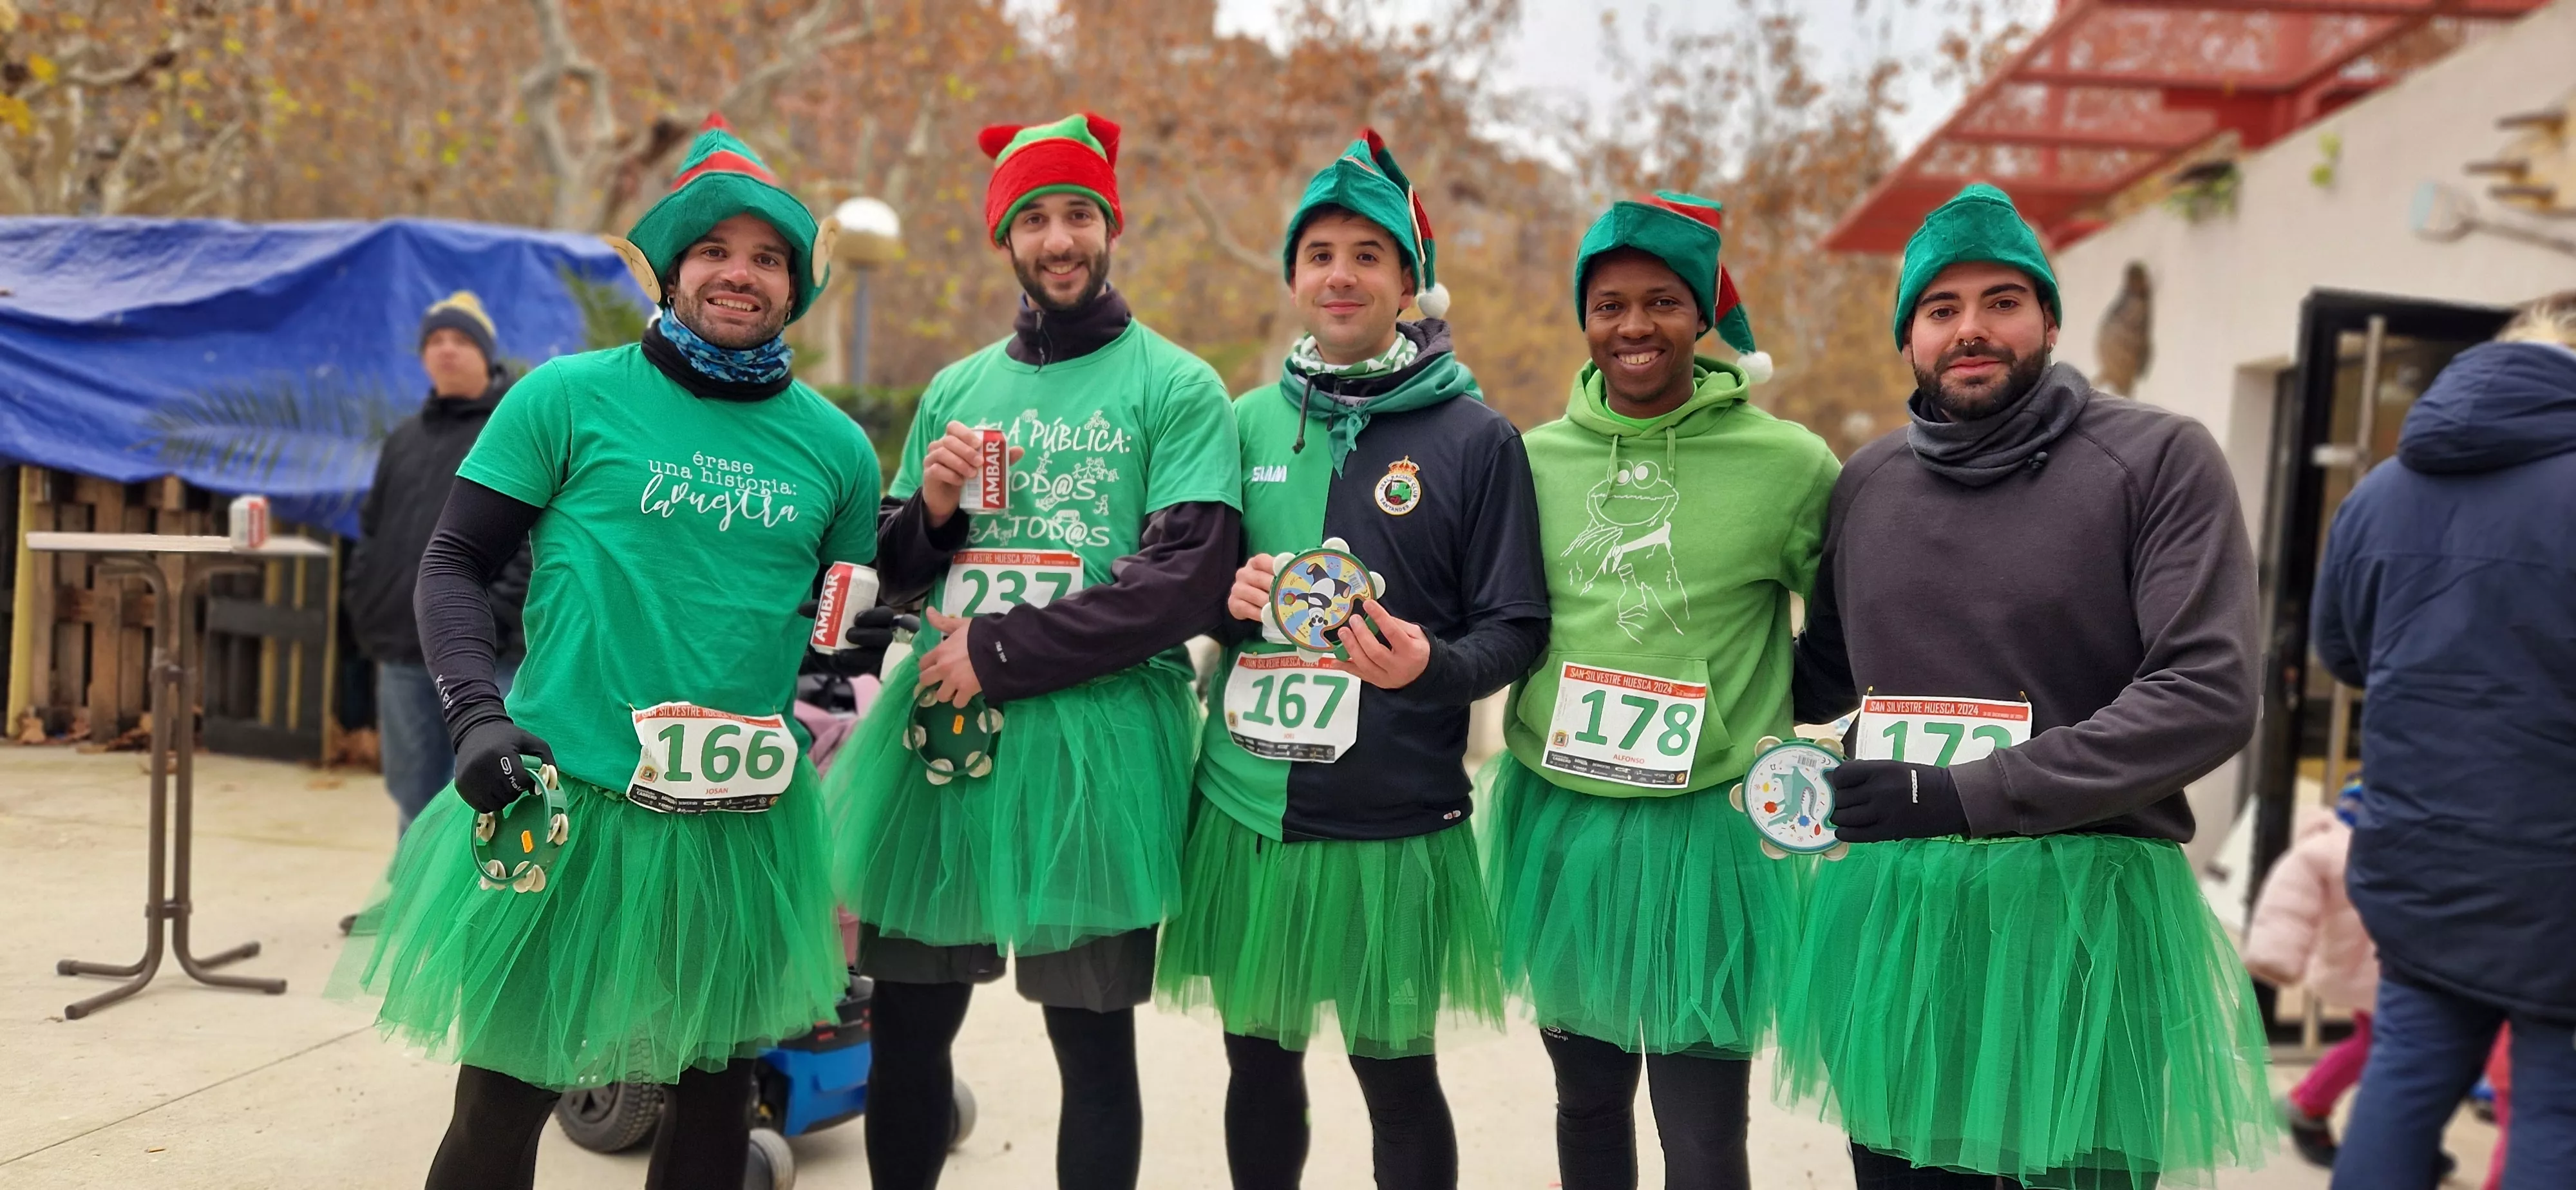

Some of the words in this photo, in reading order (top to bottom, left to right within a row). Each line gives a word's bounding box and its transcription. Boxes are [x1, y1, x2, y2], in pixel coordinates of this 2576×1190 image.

[1030, 417, 1131, 453] PÚBLICA:
[648, 460, 692, 479] una
[701, 468, 798, 495] historia:
[693, 451, 753, 474] érase
[985, 440, 1000, 505] AMBAR
[1010, 471, 1097, 502] OD@S
[1379, 478, 1390, 490] REAL
[671, 482, 799, 531] vuestra
[1380, 498, 1410, 512] SANTANDER
[1009, 516, 1110, 547] TOD@S
[966, 553, 992, 563] SILVESTRE
[994, 553, 1020, 563] HUESCA
[1022, 554, 1041, 564] 2024
[815, 573, 841, 643] AMBAR
[1280, 656, 1300, 667] HUESCA
[1570, 667, 1584, 677] SAN
[1586, 670, 1621, 685] SILVESTRE
[1623, 679, 1651, 691] HUESCA
[1653, 683, 1672, 694] 2024
[659, 706, 701, 717] SILVESTRE
[1243, 673, 1349, 729] 167
[1870, 701, 1884, 712] SAN
[1886, 701, 1922, 713] SILVESTRE
[1924, 703, 1955, 714] HUESCA
[1957, 704, 1978, 715] 2024
[1575, 690, 1696, 757] 178
[658, 724, 784, 782] 166
[1613, 754, 1645, 764] ALFONSO
